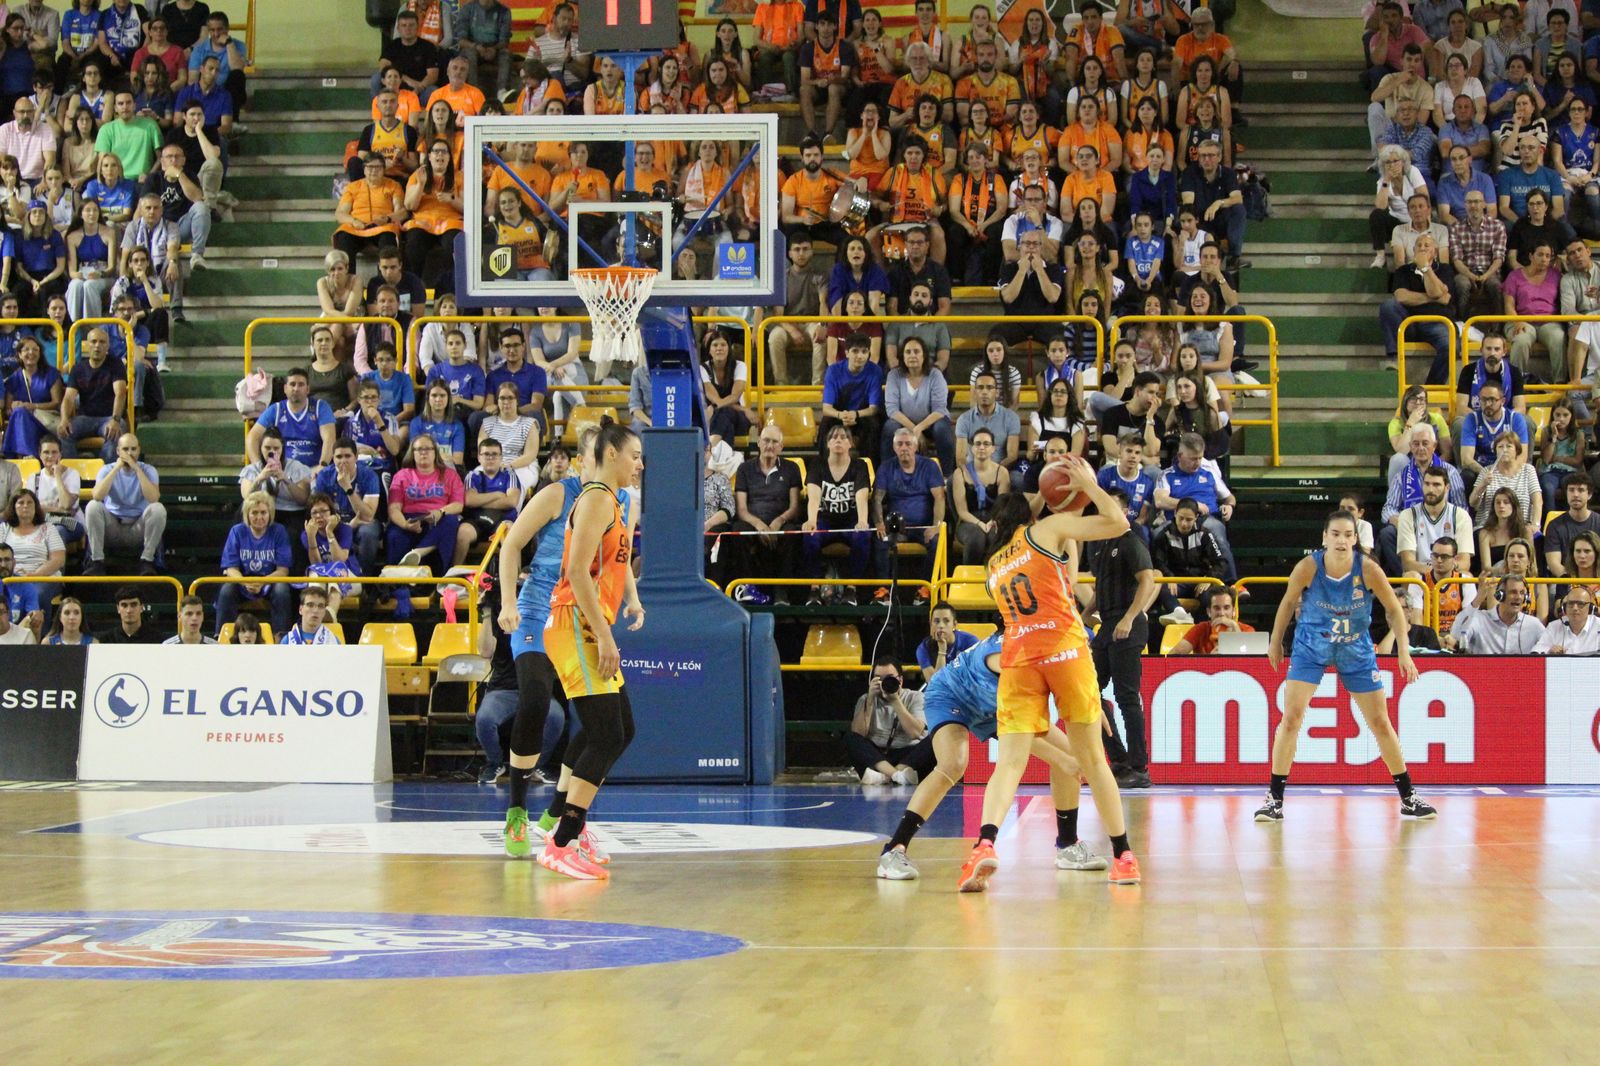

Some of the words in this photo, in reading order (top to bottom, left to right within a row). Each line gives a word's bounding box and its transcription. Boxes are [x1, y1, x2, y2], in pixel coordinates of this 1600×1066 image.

[665, 386, 676, 427] MONDO
[406, 486, 445, 499] CLUB
[1000, 572, 1038, 622] 10
[1331, 618, 1350, 633] 21
[621, 659, 664, 669] CASTILLA
[667, 661, 675, 671] Y
[677, 660, 702, 671] LEÓN
[162, 689, 207, 716] EL
[219, 686, 364, 717] GANSO
[206, 732, 285, 743] PERFUMES
[698, 758, 740, 767] MONDO
